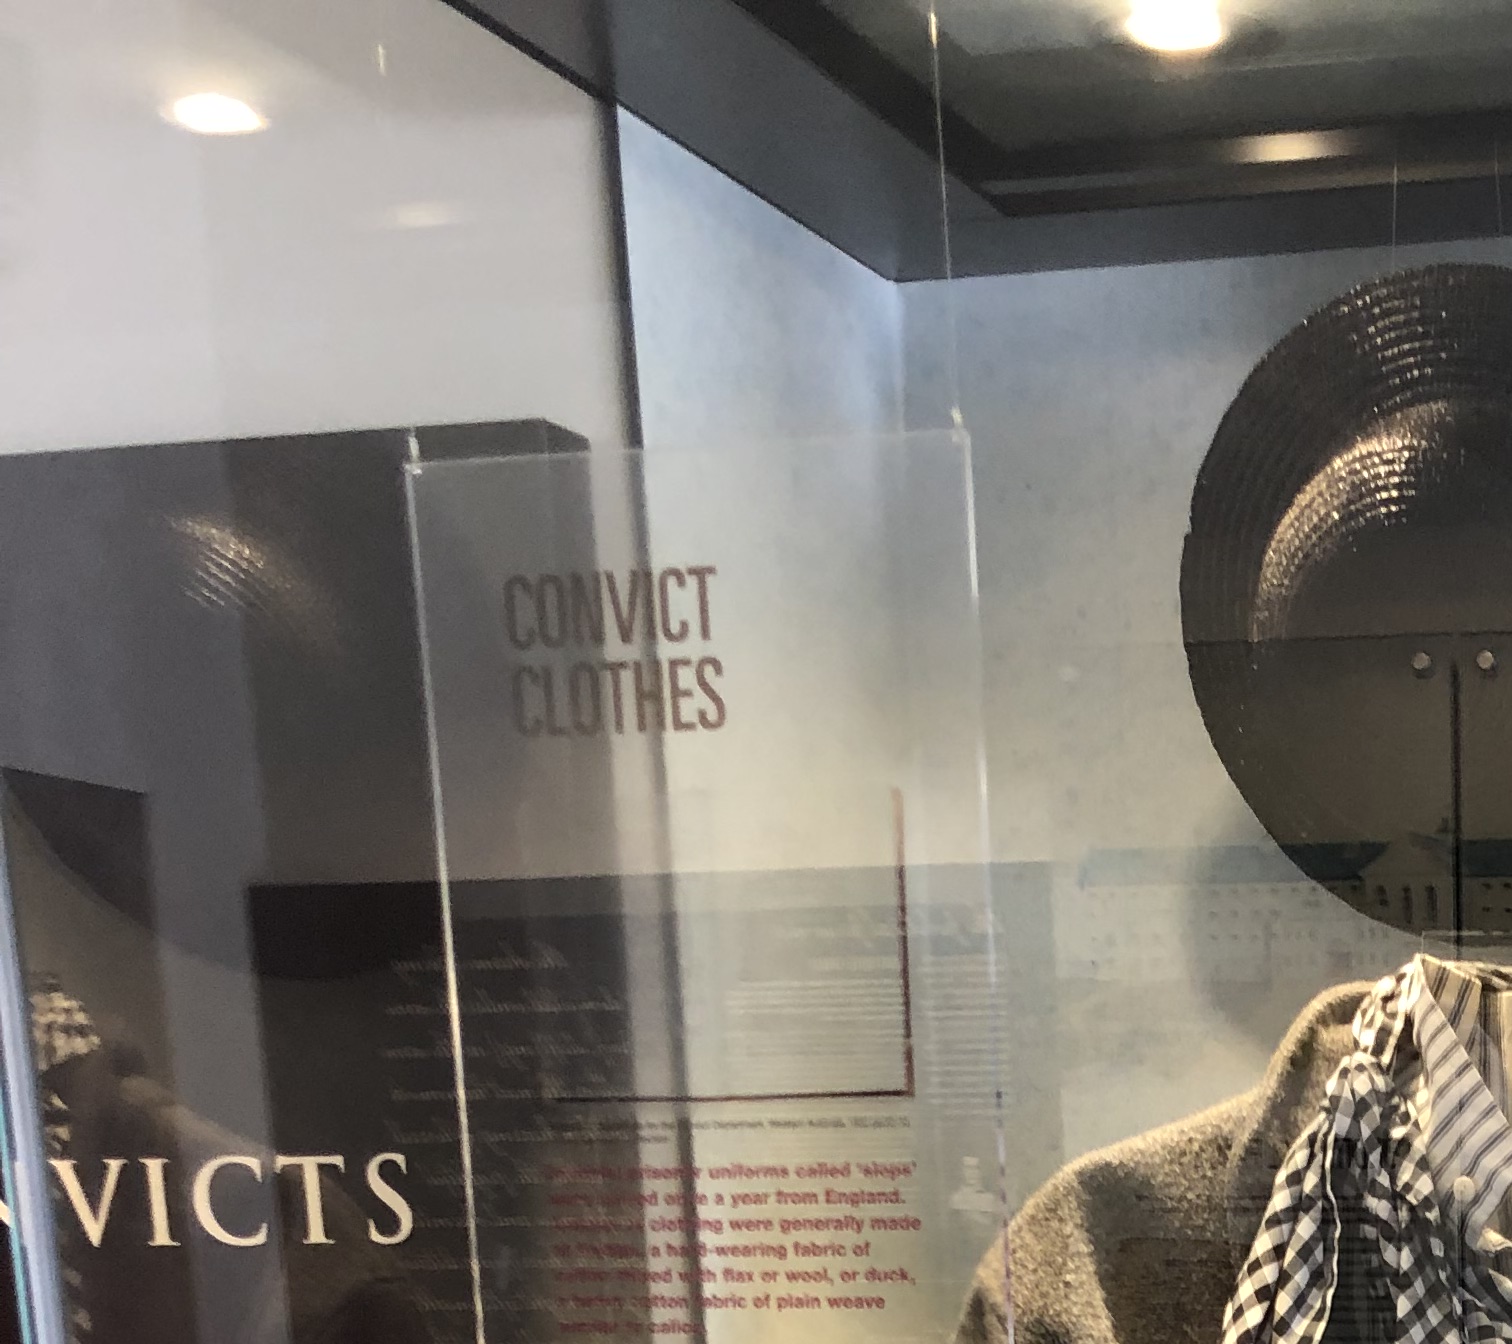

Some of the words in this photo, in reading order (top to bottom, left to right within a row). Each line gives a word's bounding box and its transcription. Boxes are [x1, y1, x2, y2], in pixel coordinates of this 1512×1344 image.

[503, 565, 717, 650] CONVICT
[511, 656, 726, 737] CLOTHES
[708, 1163, 790, 1180] uniforms
[794, 1162, 850, 1179] called
[0, 1152, 414, 1248] VICTS
[730, 1193, 771, 1209] year
[775, 1188, 819, 1204] from
[825, 1188, 906, 1208] England.
[729, 1219, 774, 1231] were
[779, 1215, 864, 1235] generally
[870, 1215, 921, 1231] made
[792, 1240, 847, 1258] fabric
[852, 1240, 871, 1257] of
[760, 1270, 780, 1283] or
[785, 1265, 834, 1287] wool,
[839, 1269, 860, 1282] or
[864, 1265, 916, 1287] duck,
[753, 1292, 771, 1309] of
[777, 1292, 822, 1312] plain
[827, 1296, 885, 1310] weave
